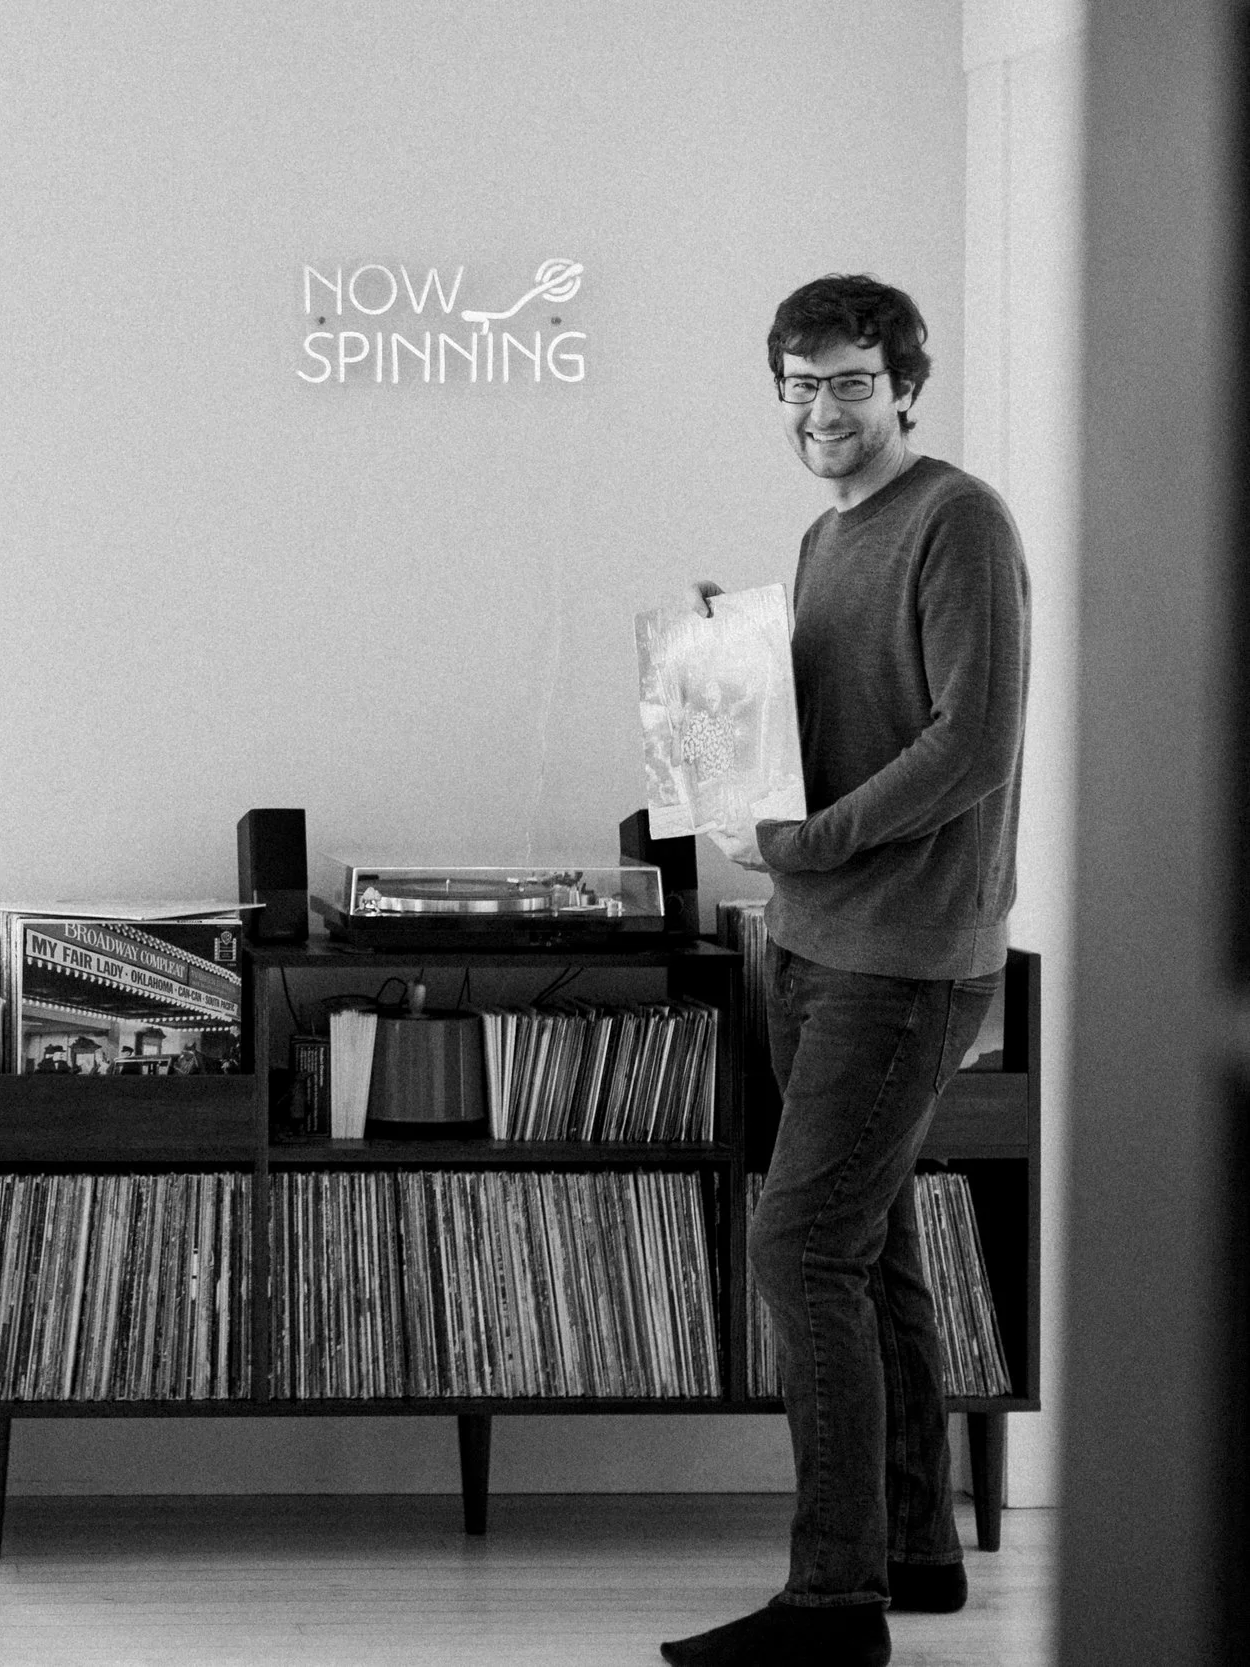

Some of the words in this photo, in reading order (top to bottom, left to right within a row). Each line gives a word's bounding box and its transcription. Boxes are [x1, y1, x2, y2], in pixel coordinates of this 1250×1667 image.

[304, 264, 464, 315] NOW
[296, 331, 587, 384] SPINNING
[32, 935, 58, 959] MY
[63, 946, 92, 970] FAIR
[97, 958, 124, 979] LADY
[131, 970, 174, 994] OKLAHOMA
[64, 923, 139, 962] BROADWAY
[140, 950, 186, 978] COMPLEAT
